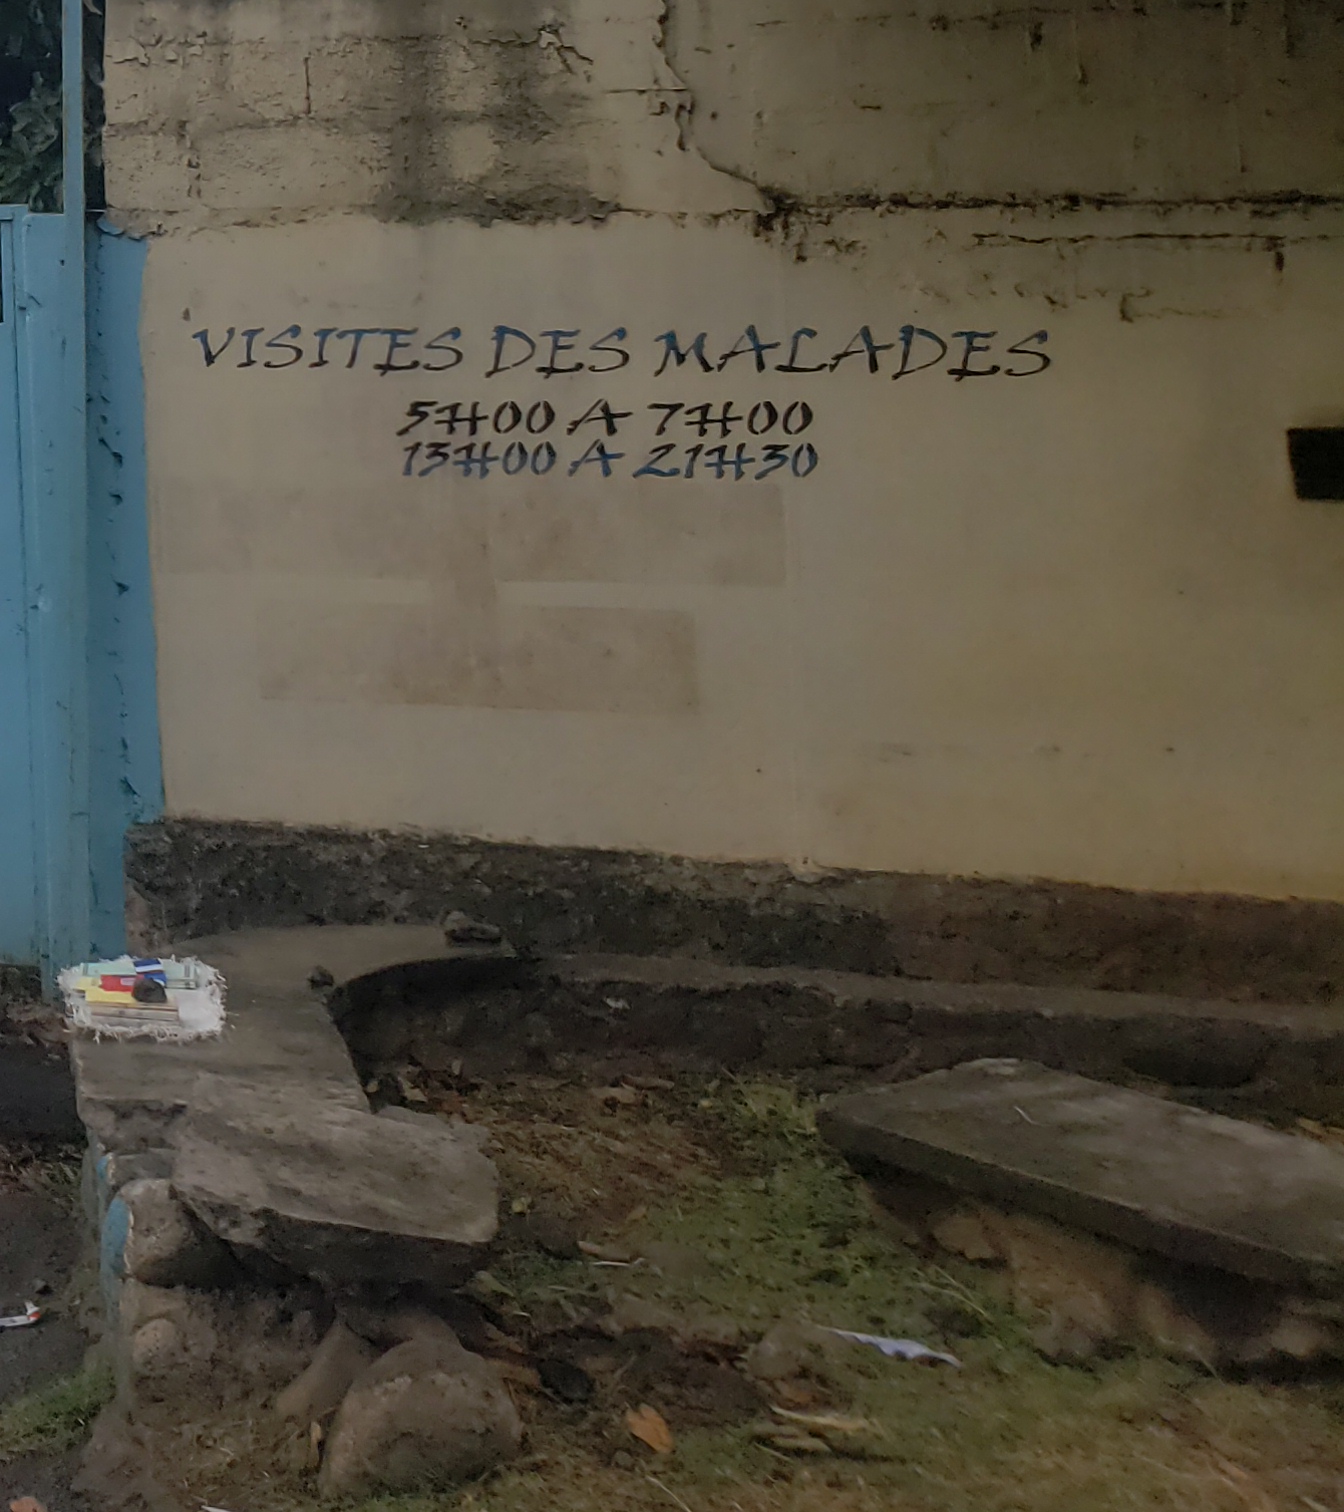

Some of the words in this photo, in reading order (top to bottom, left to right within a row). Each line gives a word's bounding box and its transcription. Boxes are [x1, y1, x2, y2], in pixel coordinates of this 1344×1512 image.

[192, 324, 465, 372] VISITES
[484, 325, 631, 378] DES
[652, 324, 1054, 382] MALADES
